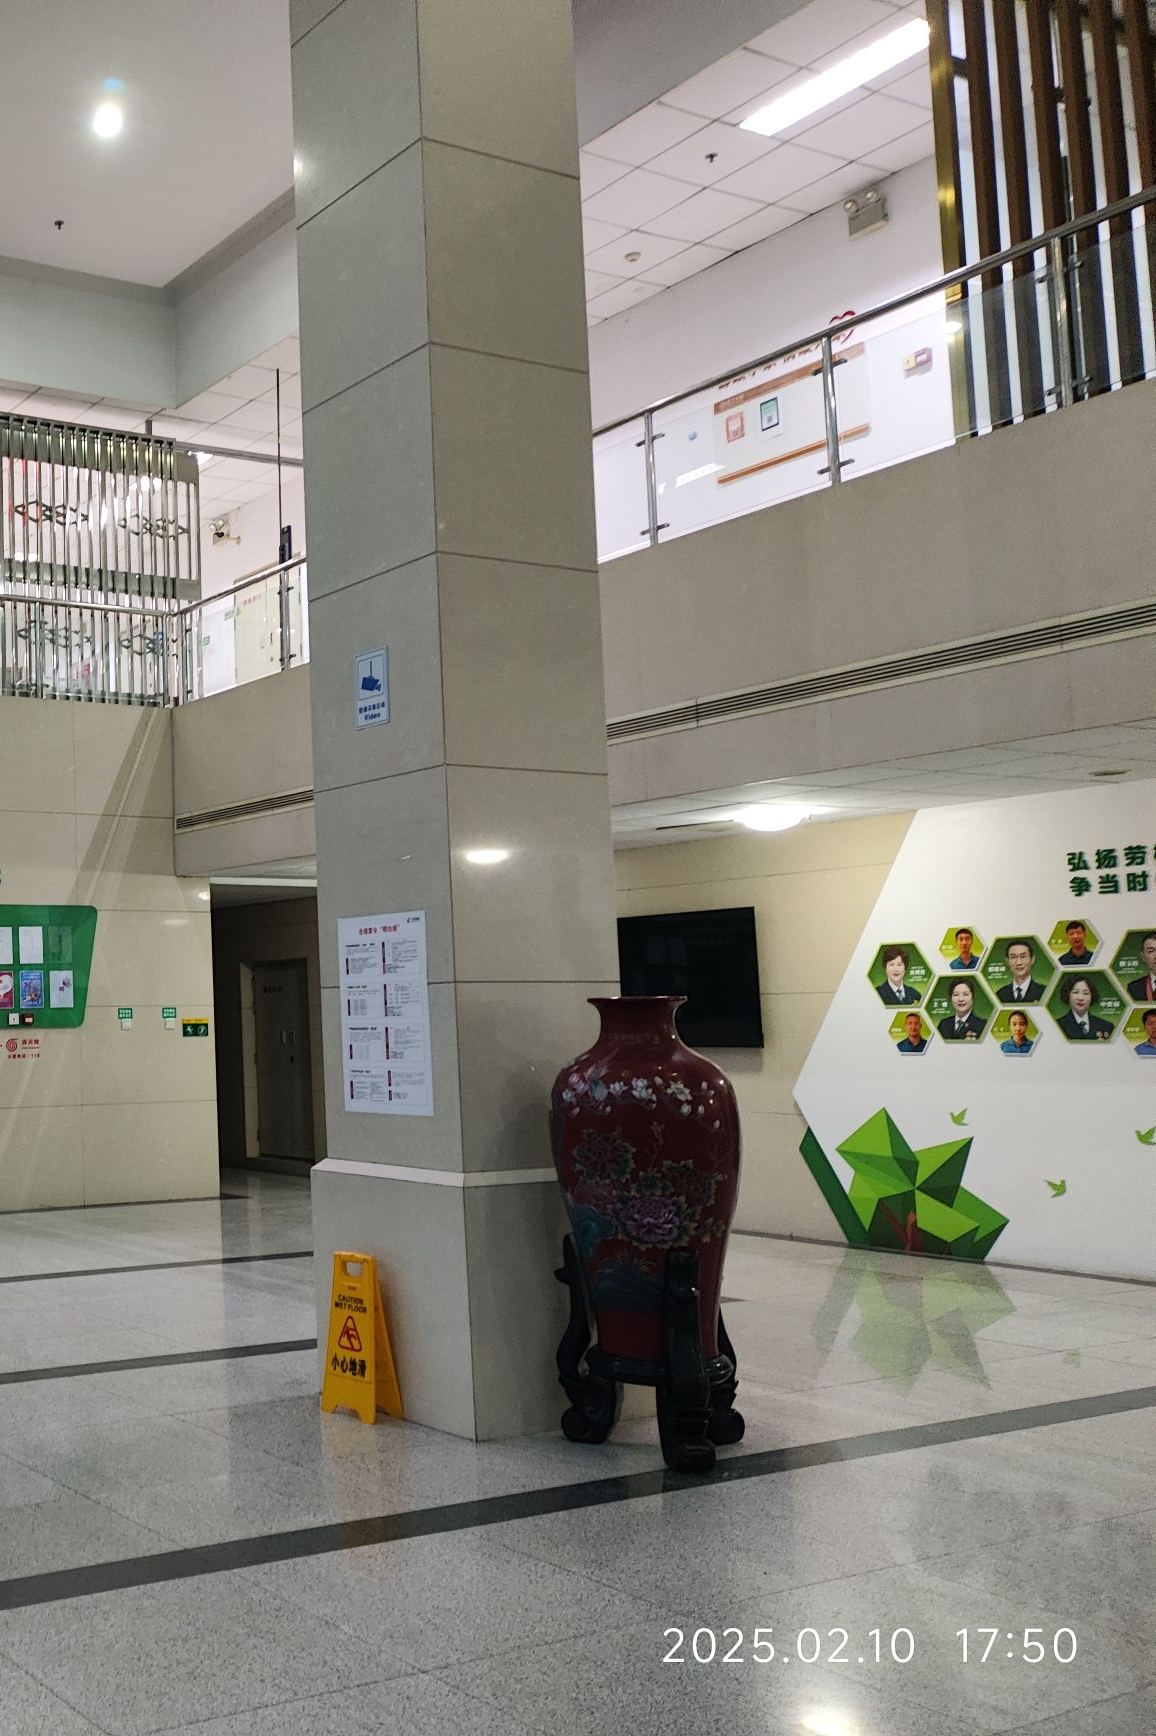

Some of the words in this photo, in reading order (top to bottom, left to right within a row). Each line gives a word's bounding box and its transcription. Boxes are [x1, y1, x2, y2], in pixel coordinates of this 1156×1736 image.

[1066, 843, 1156, 873] 弘扬劳
[1068, 869, 1150, 897] 争当时
[334, 1301, 347, 1310] WET
[348, 1304, 367, 1313] FLOOR
[338, 1293, 364, 1305] CAUTION
[331, 1352, 367, 1379] 小心地滑
